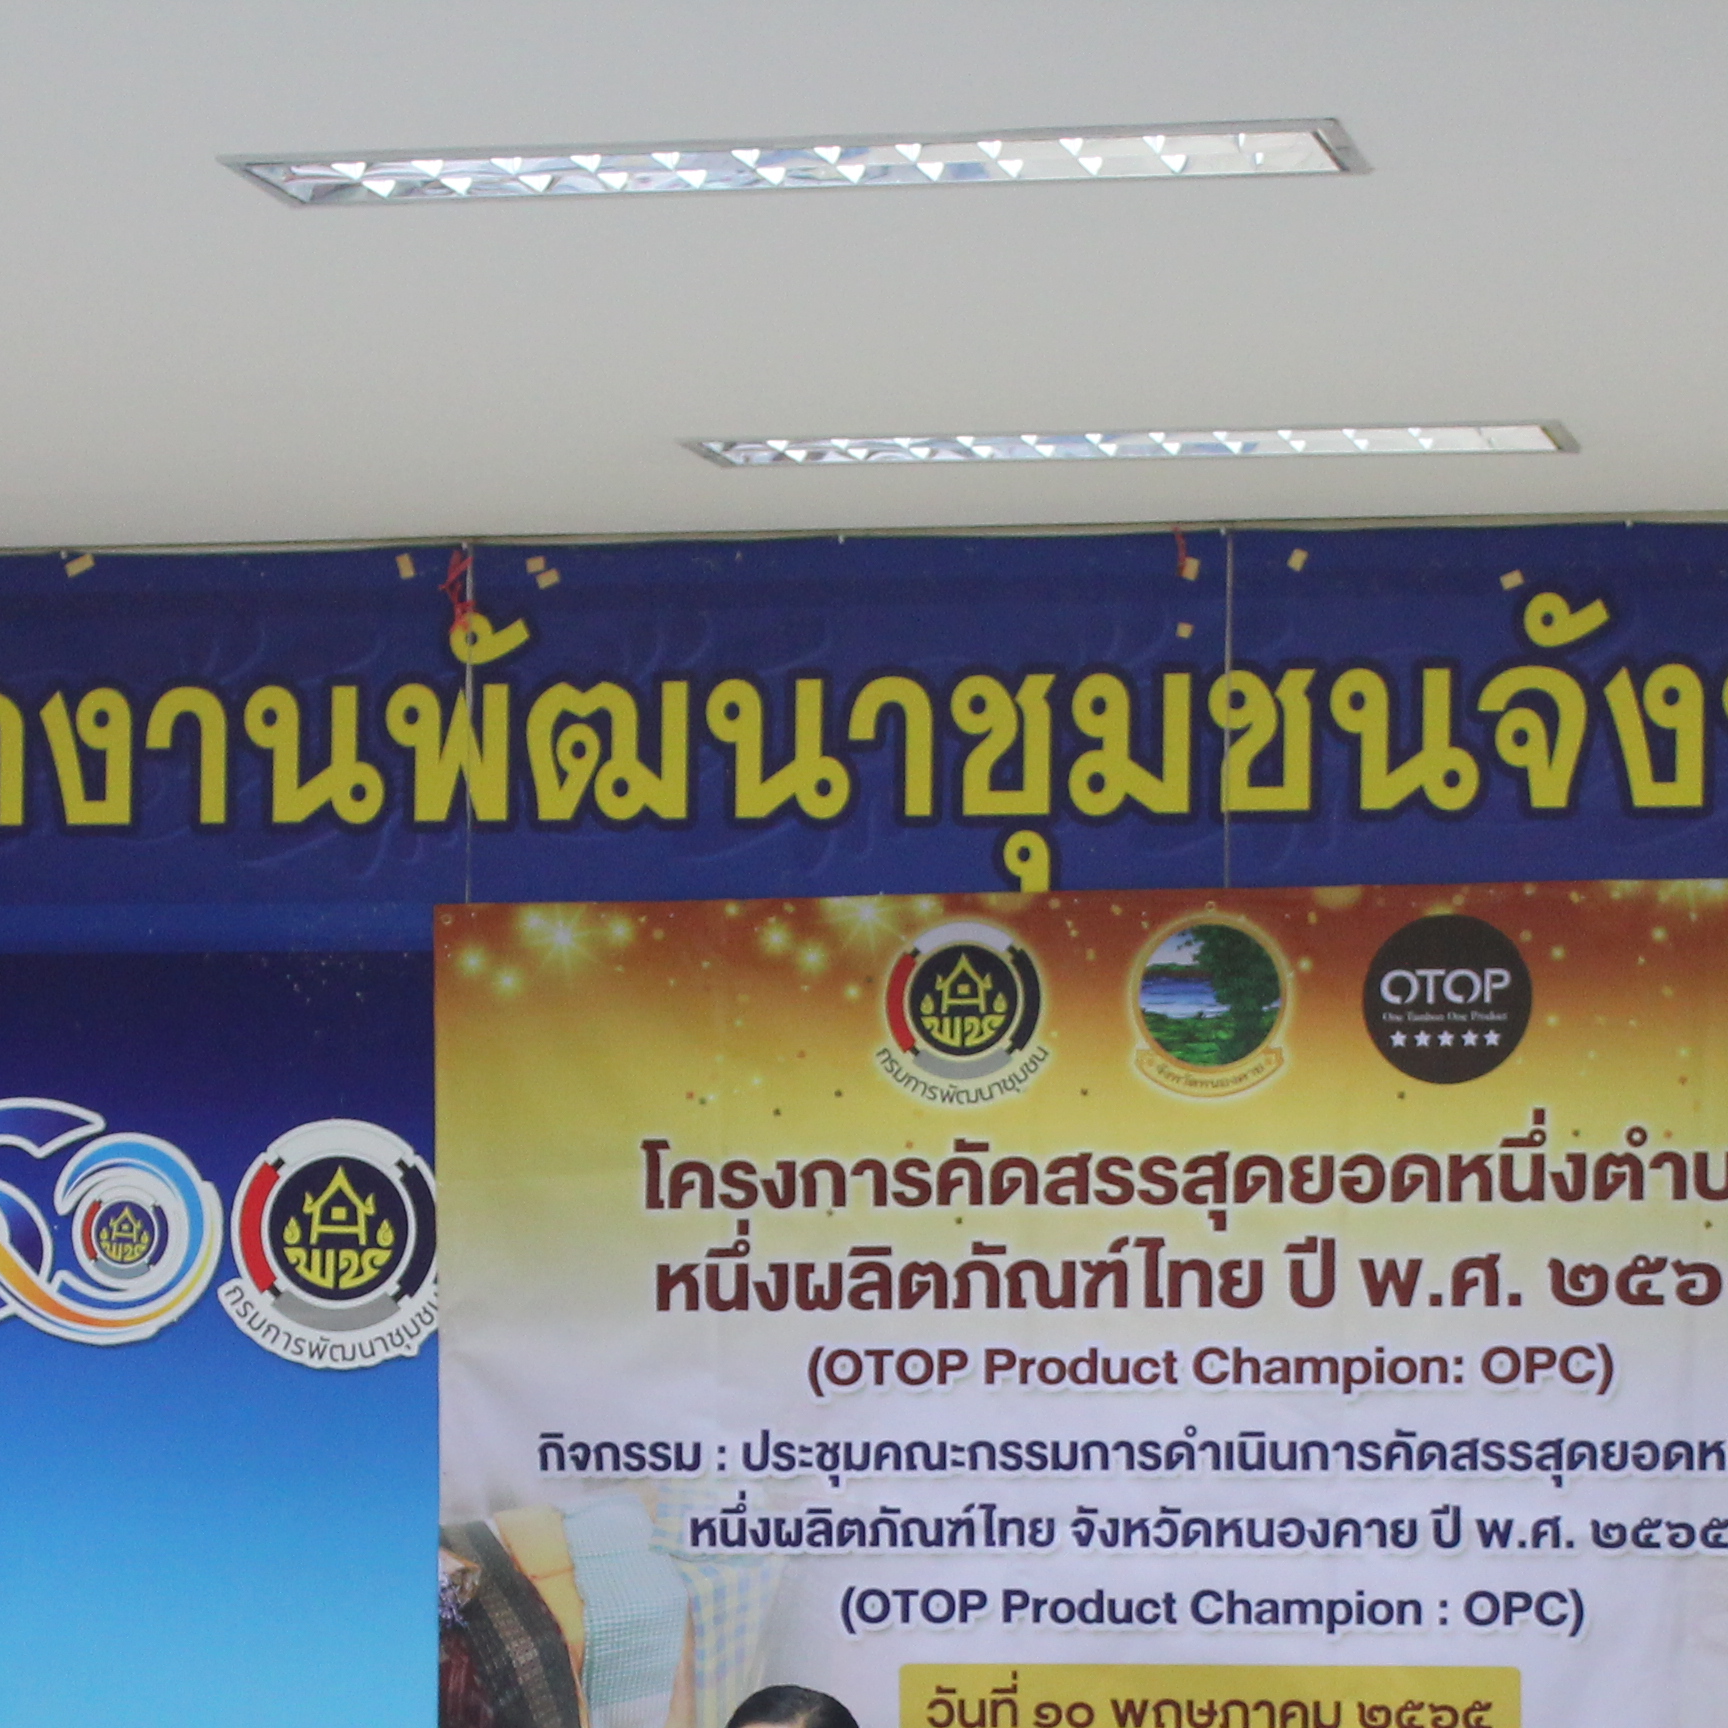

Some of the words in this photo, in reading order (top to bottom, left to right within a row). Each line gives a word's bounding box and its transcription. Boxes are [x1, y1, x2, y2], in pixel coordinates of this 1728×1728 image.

[1380, 968, 1511, 1005] OTOP
[876, 1045, 1049, 1104] กรมการพัฒนาชุมชน
[656, 1219, 1263, 1311] หนึ่งผลิตภัณฑ์ไทย
[1285, 1236, 1336, 1308] ปี
[1359, 1253, 1522, 1307] พ.ศ.
[225, 1282, 439, 1363] กรมการพัฒนาชุมช
[808, 1346, 969, 1398] (OTOP
[985, 1347, 1178, 1386] Product
[1193, 1346, 1463, 1395] Champion:
[1481, 1343, 1614, 1396] OPC)
[538, 1432, 701, 1472] กิจกรรม
[690, 1490, 1055, 1548] หนึ่งผลิตภัณฑ์ไทย
[1071, 1505, 1418, 1549] จังหวัดหนองคาย
[1431, 1504, 1462, 1549] ปี
[1476, 1516, 1574, 1549] พ.ศ.
[841, 1586, 988, 1635] (OTOP
[1002, 1589, 1177, 1626] Product
[1190, 1589, 1422, 1636] Champion
[1464, 1588, 1584, 1637] OPC)
[927, 1671, 1018, 1728] วันที่
